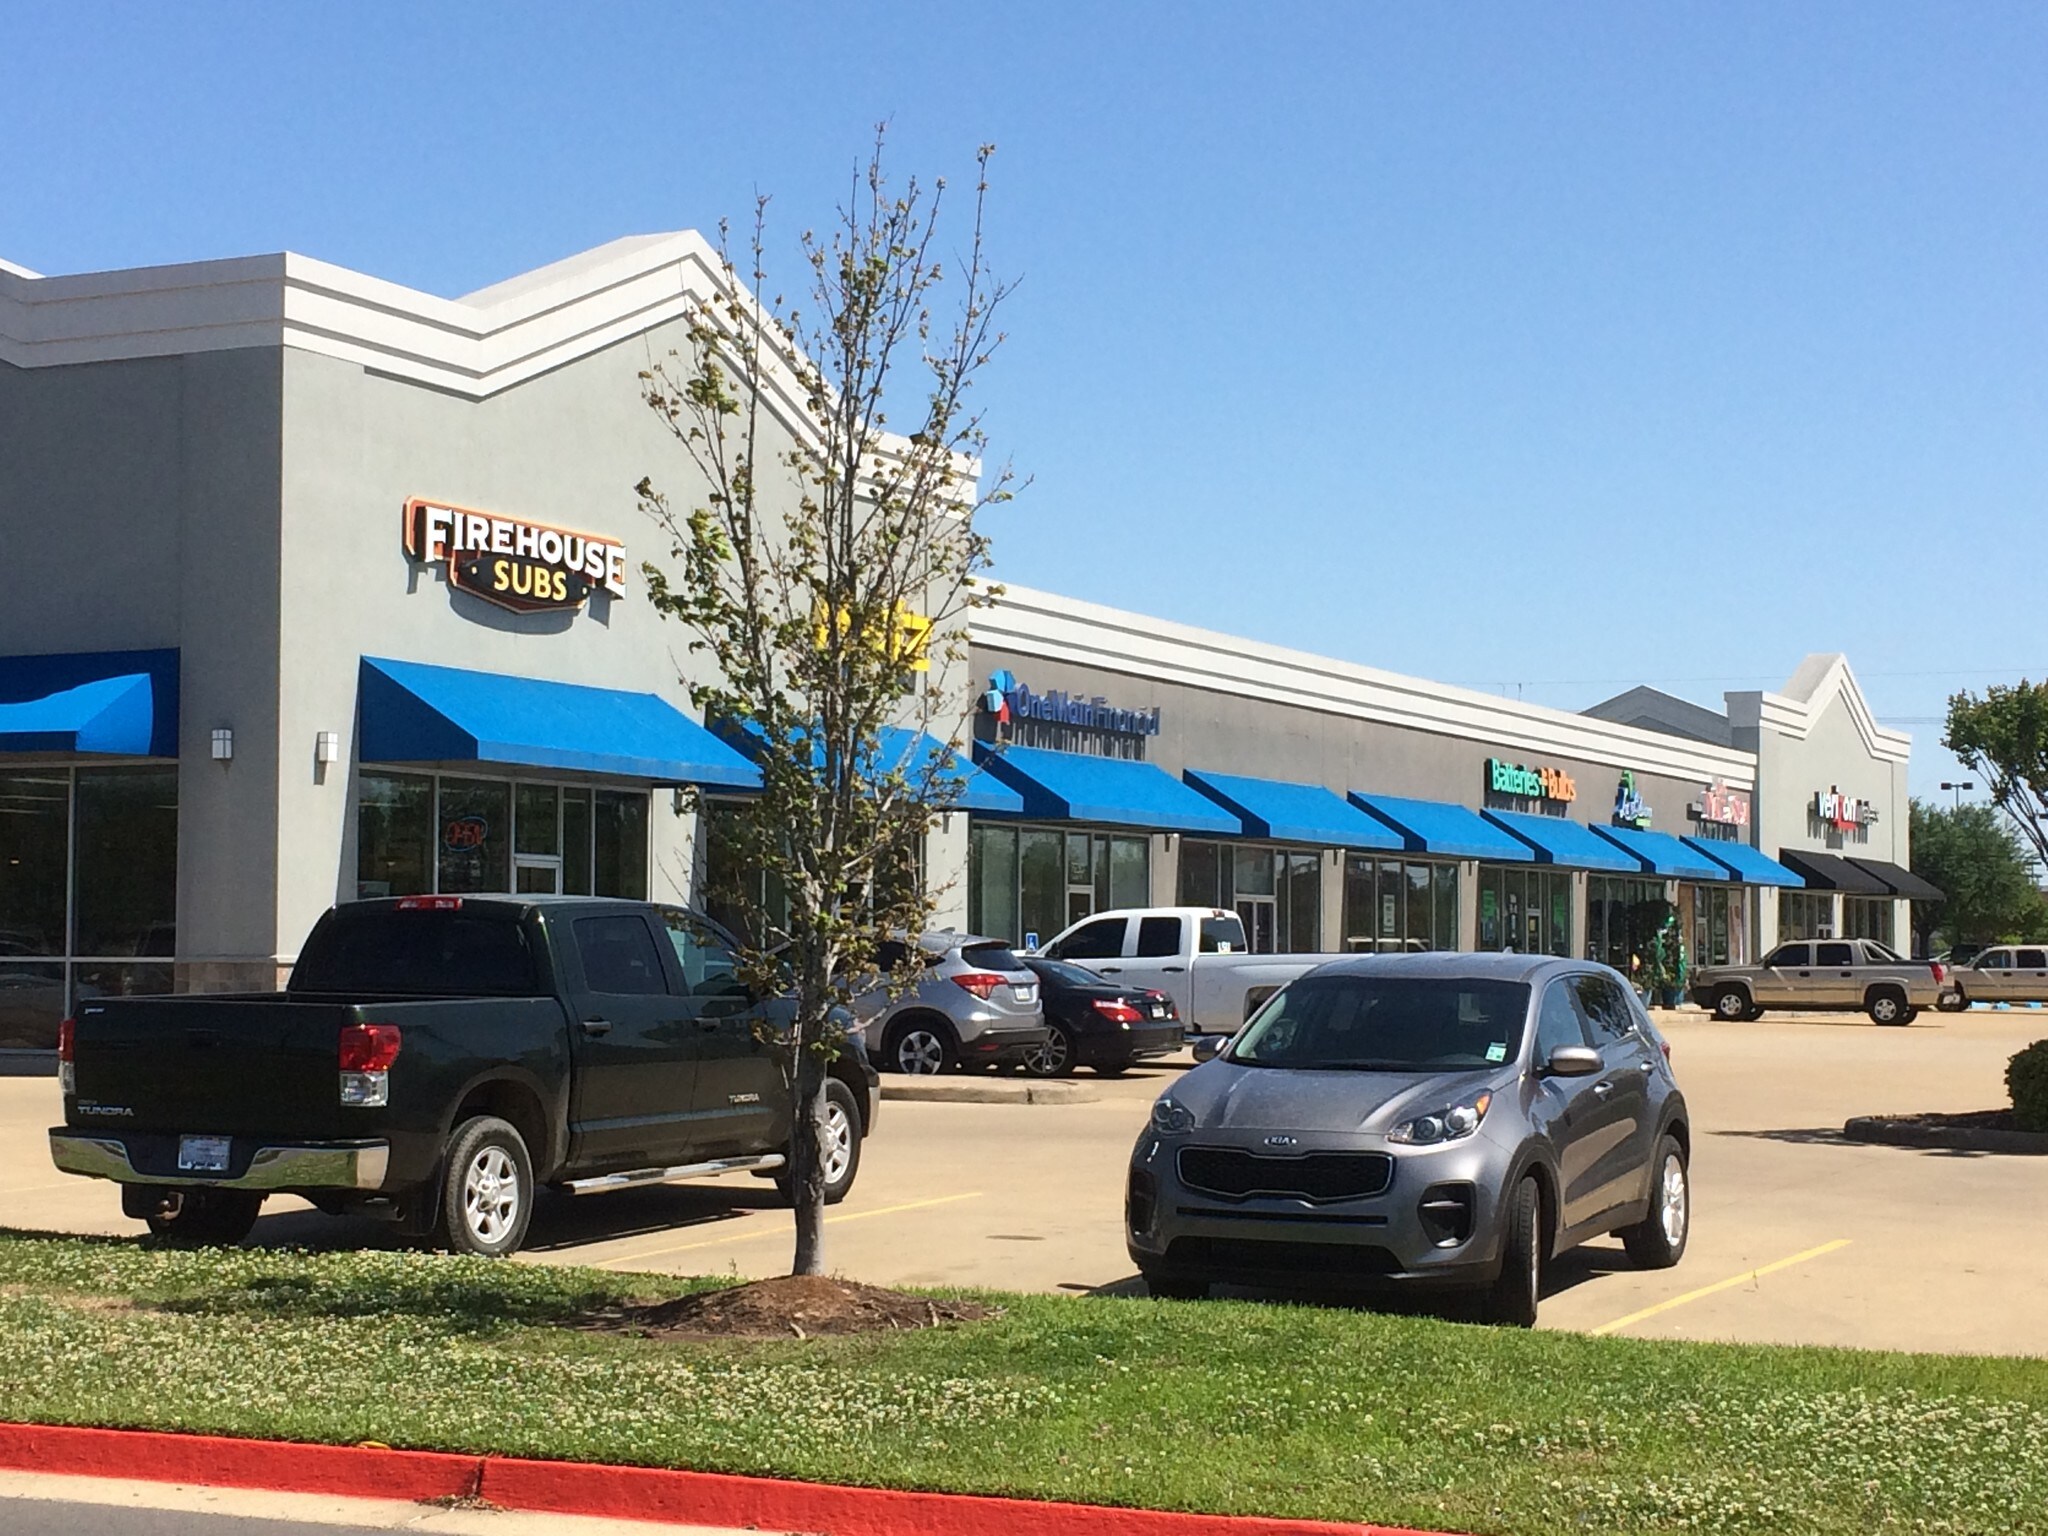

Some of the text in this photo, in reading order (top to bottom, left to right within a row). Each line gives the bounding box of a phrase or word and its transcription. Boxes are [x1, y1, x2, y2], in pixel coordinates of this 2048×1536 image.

[424, 505, 626, 600] FIREHOUSE
[494, 559, 567, 601] SUBS
[1270, 1135, 1290, 1145] KIA
